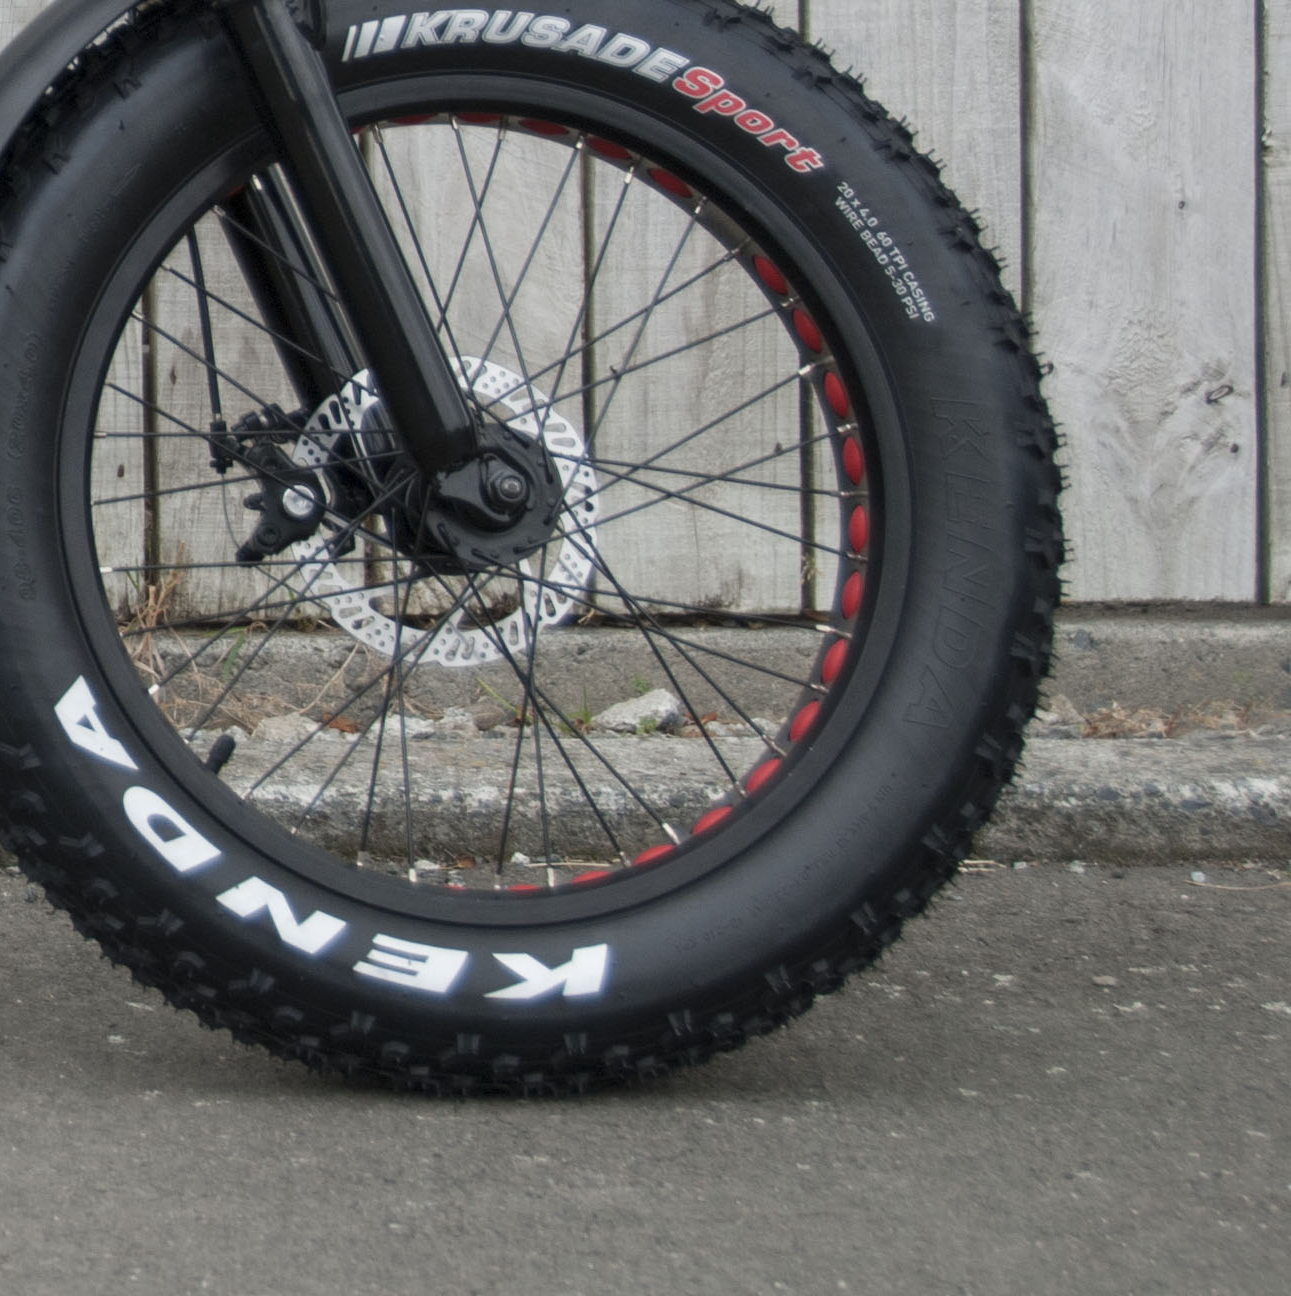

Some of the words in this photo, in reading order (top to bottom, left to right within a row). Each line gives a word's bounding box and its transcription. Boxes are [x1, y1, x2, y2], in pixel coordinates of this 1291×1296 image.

[399, 9, 689, 84] KRUSADE
[673, 66, 824, 175] Sport
[835, 196, 865, 231] WIRE
[859, 229, 890, 265] BEAD
[884, 265, 908, 296] 5-30
[901, 296, 920, 320] PSI
[837, 181, 855, 199] 20
[859, 207, 879, 228] 4.0
[876, 231, 893, 248] 60
[889, 246, 909, 271] TPI
[902, 271, 936, 323] CASING
[54, 675, 611, 1000] KENDA
